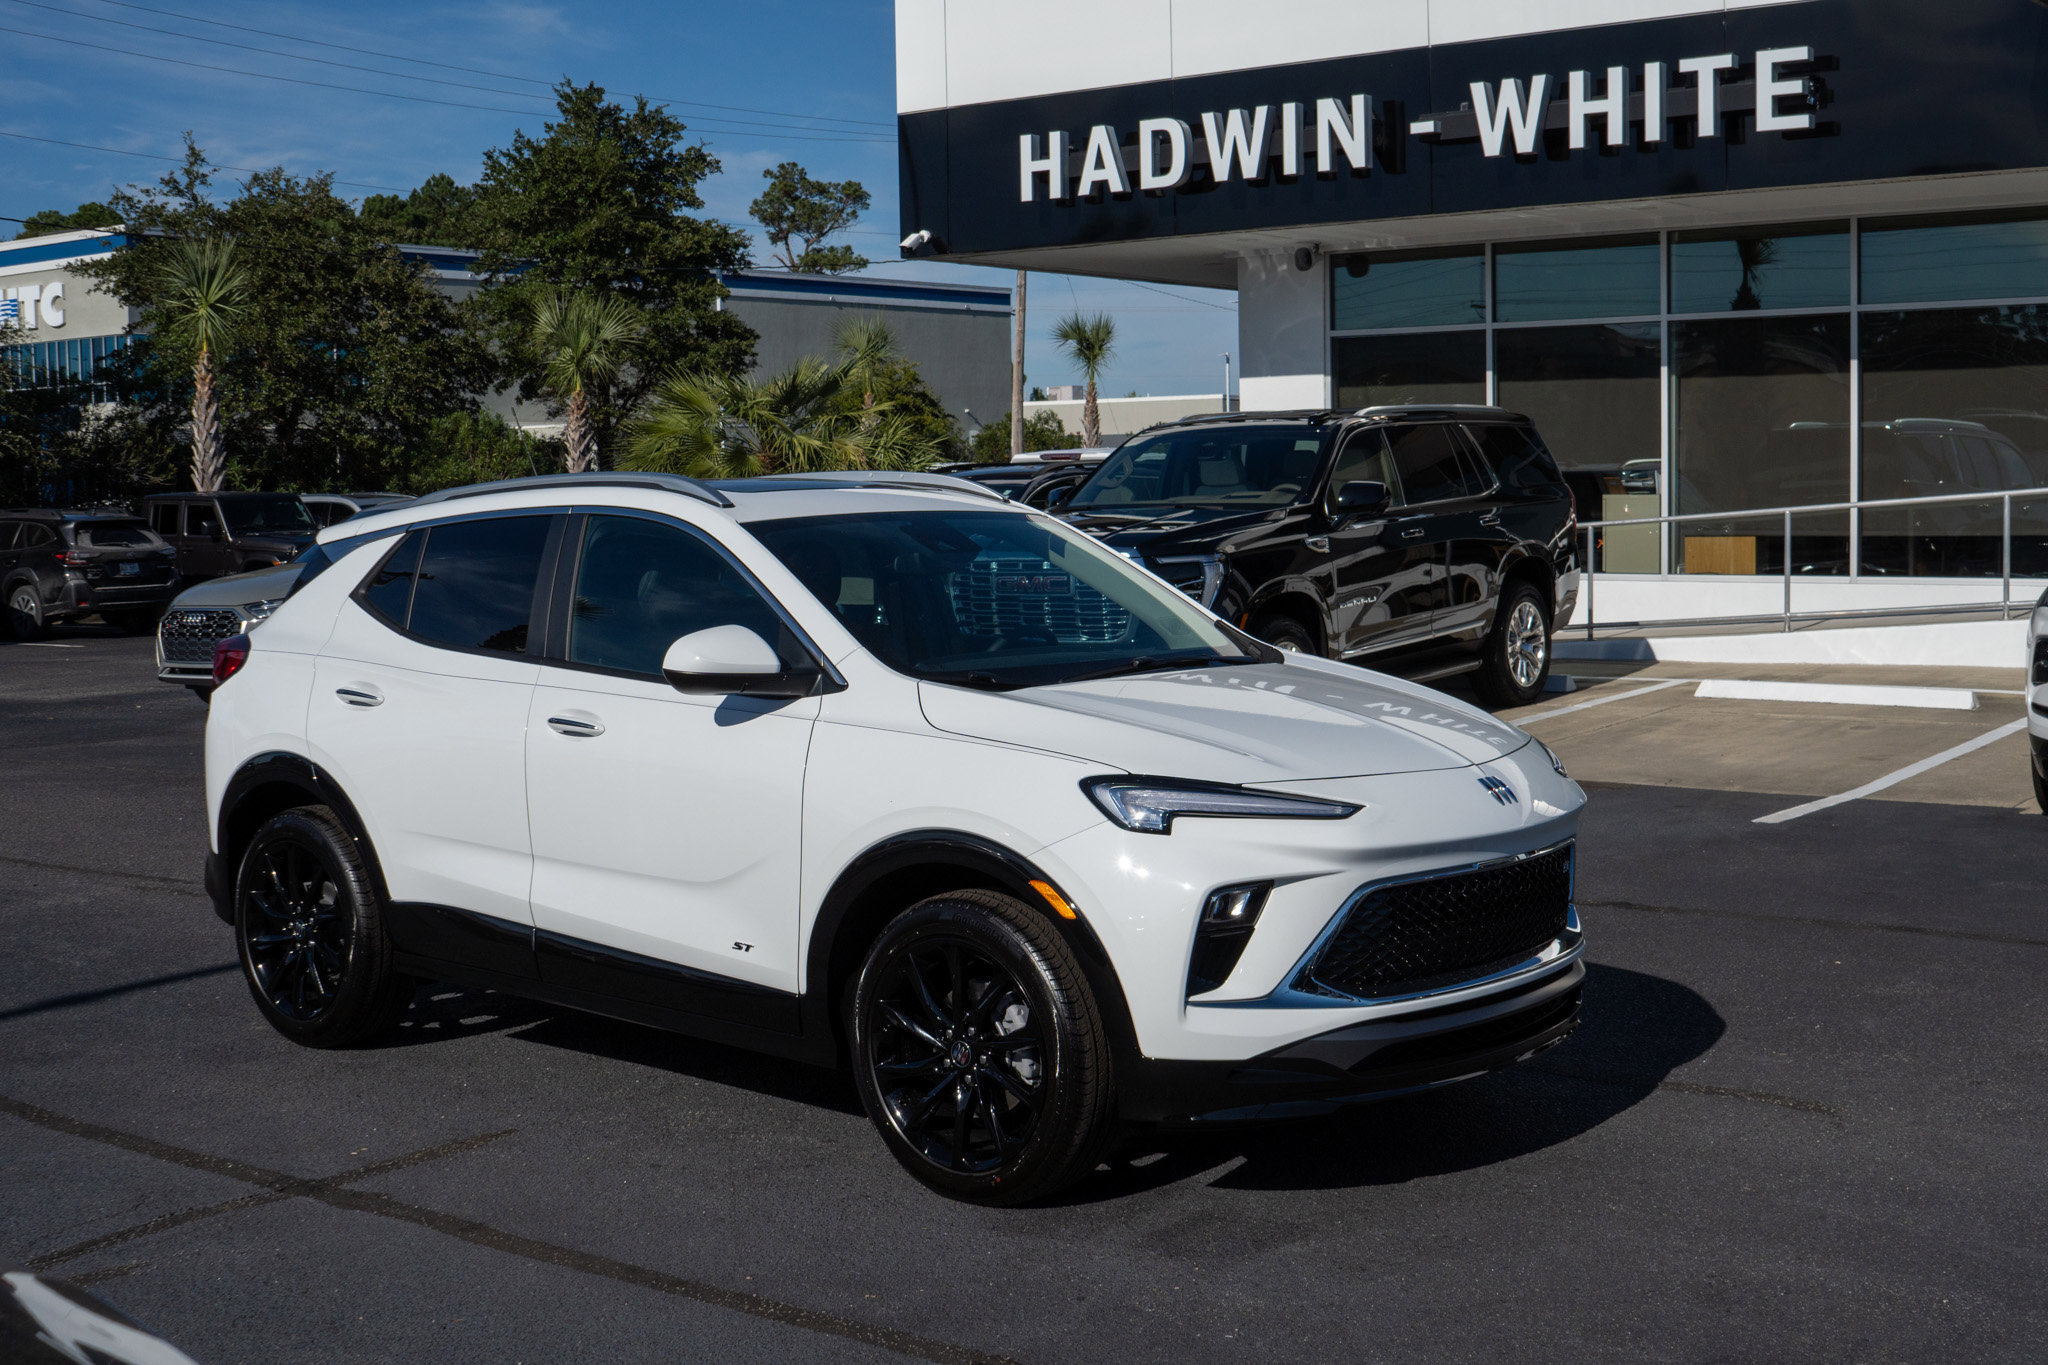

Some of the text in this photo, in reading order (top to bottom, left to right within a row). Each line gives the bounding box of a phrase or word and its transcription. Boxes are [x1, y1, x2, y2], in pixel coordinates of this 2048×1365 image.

[1019, 93, 1373, 202] HADWIN
[1469, 45, 1816, 158] WHITE
[996, 576, 1067, 592] GMC
[731, 941, 754, 953] ST
